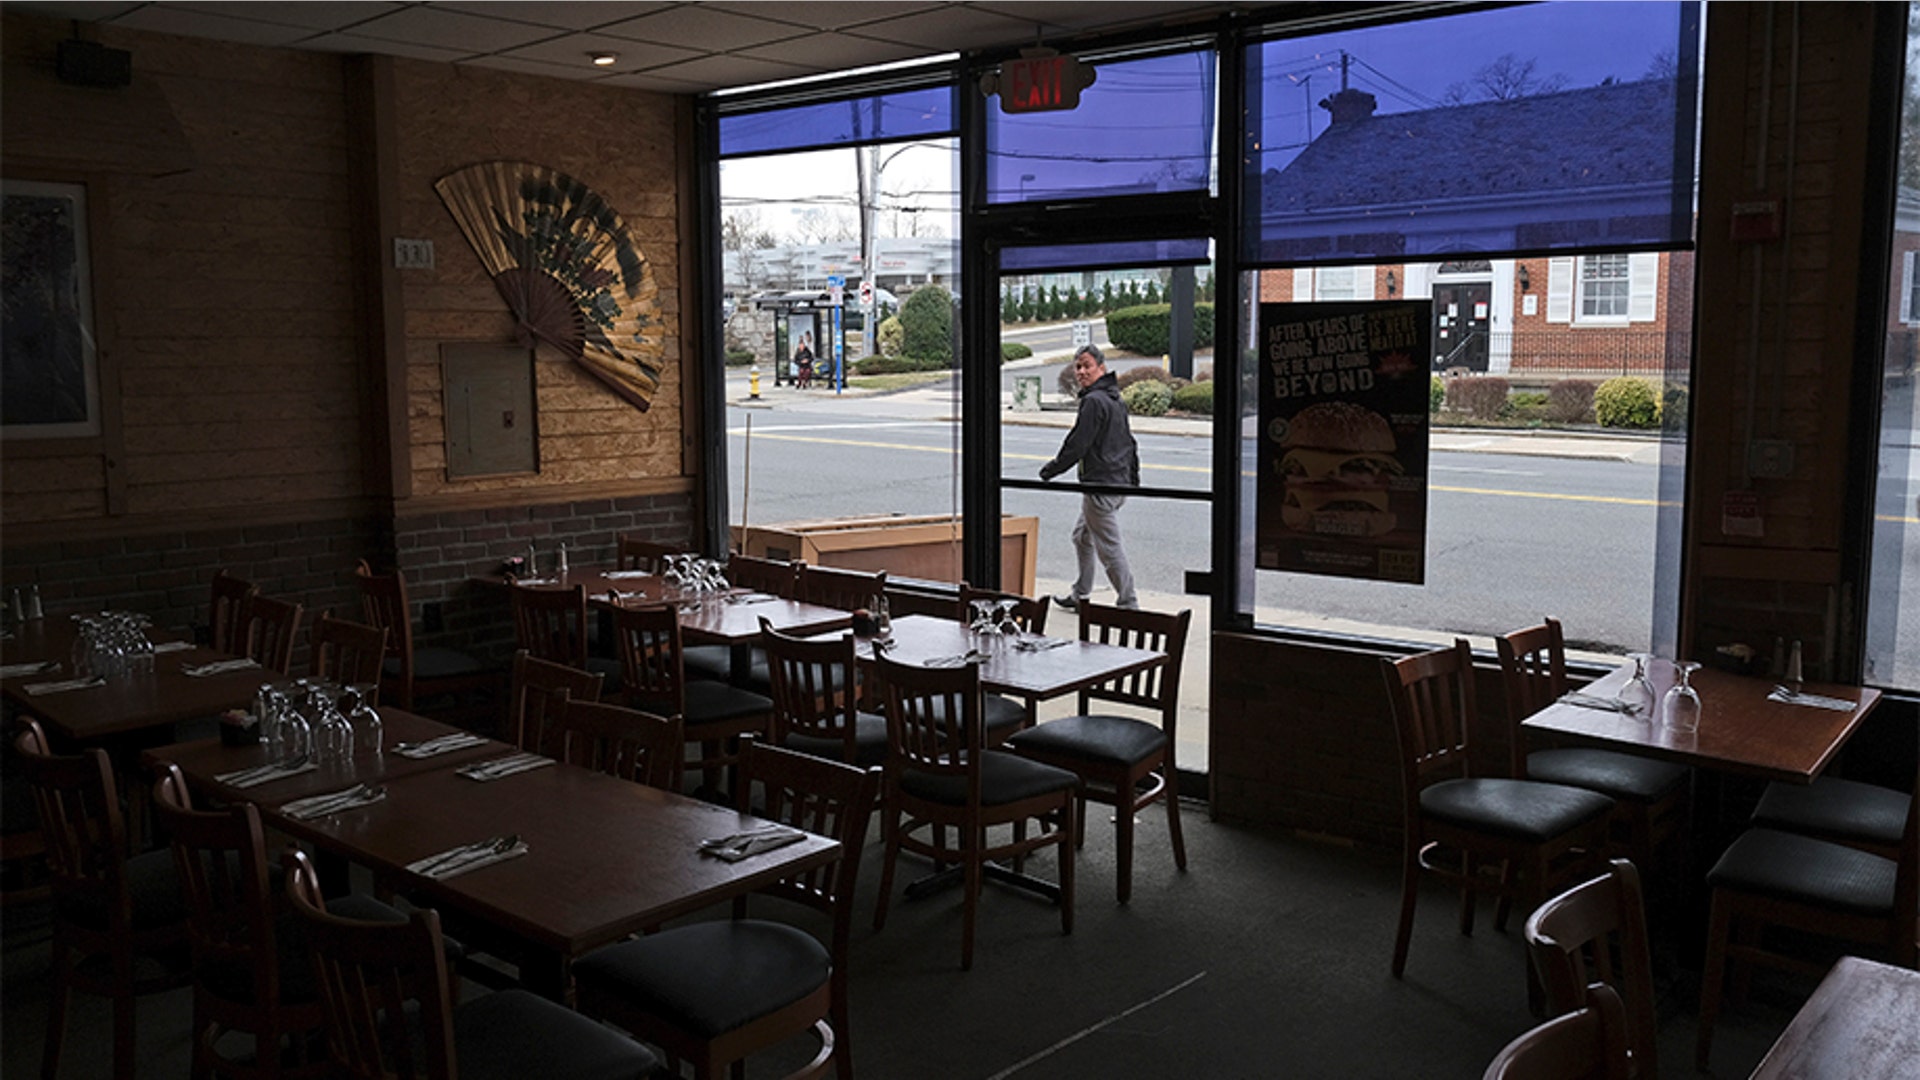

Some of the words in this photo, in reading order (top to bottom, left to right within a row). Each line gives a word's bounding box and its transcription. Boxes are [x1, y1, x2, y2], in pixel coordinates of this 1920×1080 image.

[1012, 58, 1066, 109] EXIT
[1268, 322, 1306, 343] AFTER
[1307, 315, 1347, 338] YEARS
[1348, 313, 1365, 333] OF
[1269, 339, 1313, 361] GOING
[1316, 332, 1368, 355] ABOVE
[1307, 355, 1333, 373] NOW
[1336, 351, 1370, 369] GOING
[1273, 367, 1375, 399] BEYOND
